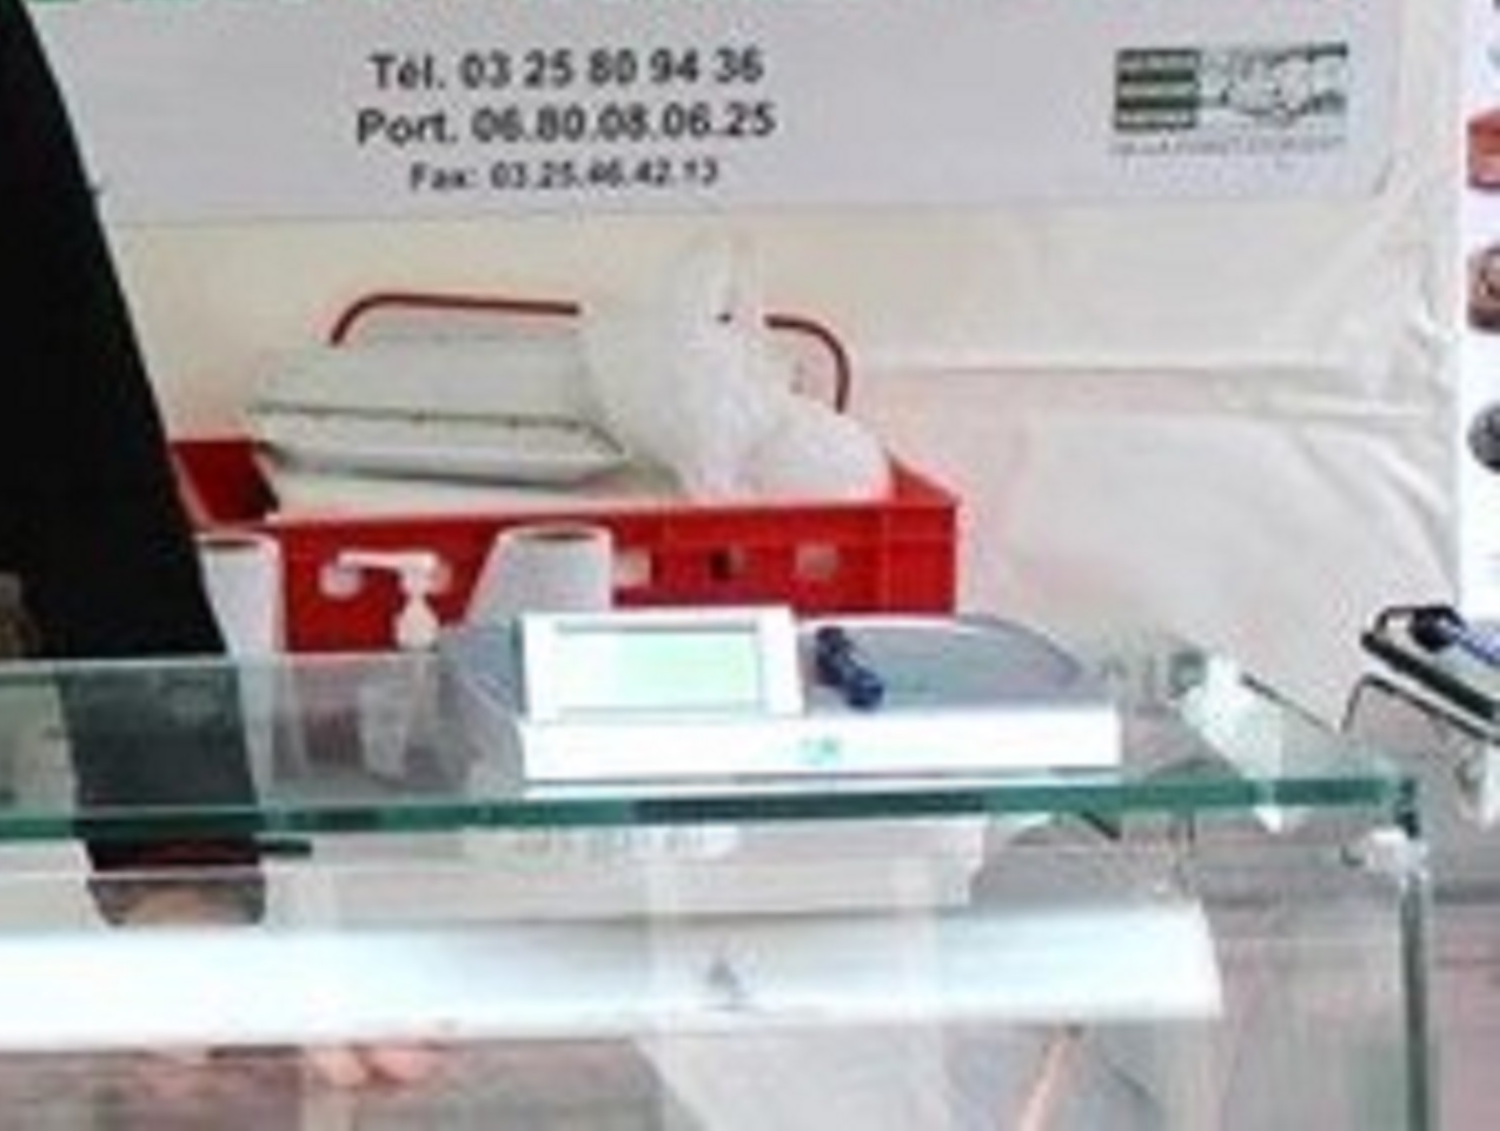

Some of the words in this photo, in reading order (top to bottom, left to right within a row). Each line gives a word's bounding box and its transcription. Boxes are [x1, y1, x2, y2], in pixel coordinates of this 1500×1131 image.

[459, 49, 510, 89] 03
[524, 48, 573, 88] 25
[588, 47, 638, 86] 80
[650, 46, 698, 84] 94
[713, 45, 764, 84] 36
[357, 107, 458, 147] Port.
